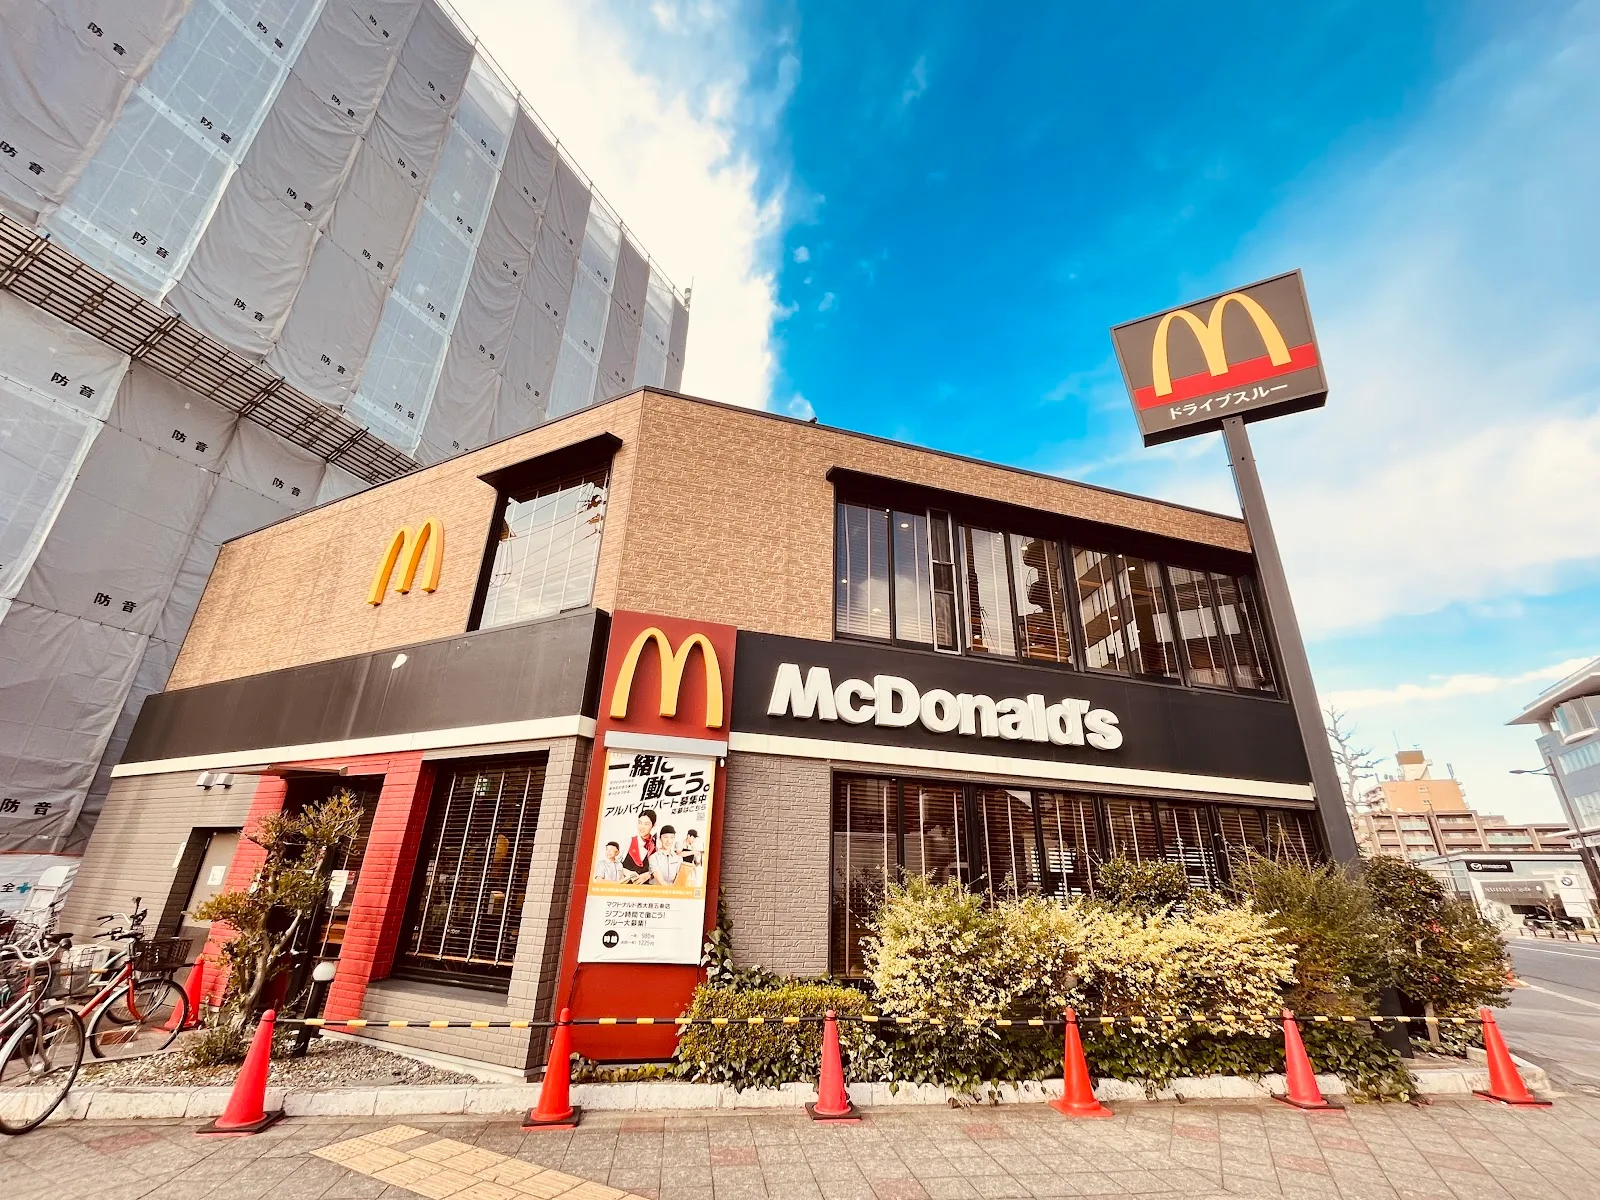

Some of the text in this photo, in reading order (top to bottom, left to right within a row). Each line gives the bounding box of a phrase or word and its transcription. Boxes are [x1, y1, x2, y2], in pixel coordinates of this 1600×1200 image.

[88, 22, 126, 55] 防音
[257, 22, 283, 48] 防音
[201, 117, 231, 143] 防音
[0, 141, 44, 175] 防音
[287, 188, 313, 211] 防音
[133, 232, 168, 258] 防音
[362, 249, 384, 270] 防音
[234, 298, 264, 321] 防音
[321, 354, 345, 374] 防音
[51, 372, 94, 398] 防音
[1170, 384, 1288, 421] ドライブスルー
[172, 430, 208, 452] 防音
[272, 478, 301, 496] 防音
[94, 593, 137, 613] 防音
[767, 662, 1123, 750] McDonald's
[609, 754, 675, 777] 一緒に
[640, 771, 710, 801] 働こう。
[0, 798, 52, 816] 防音
